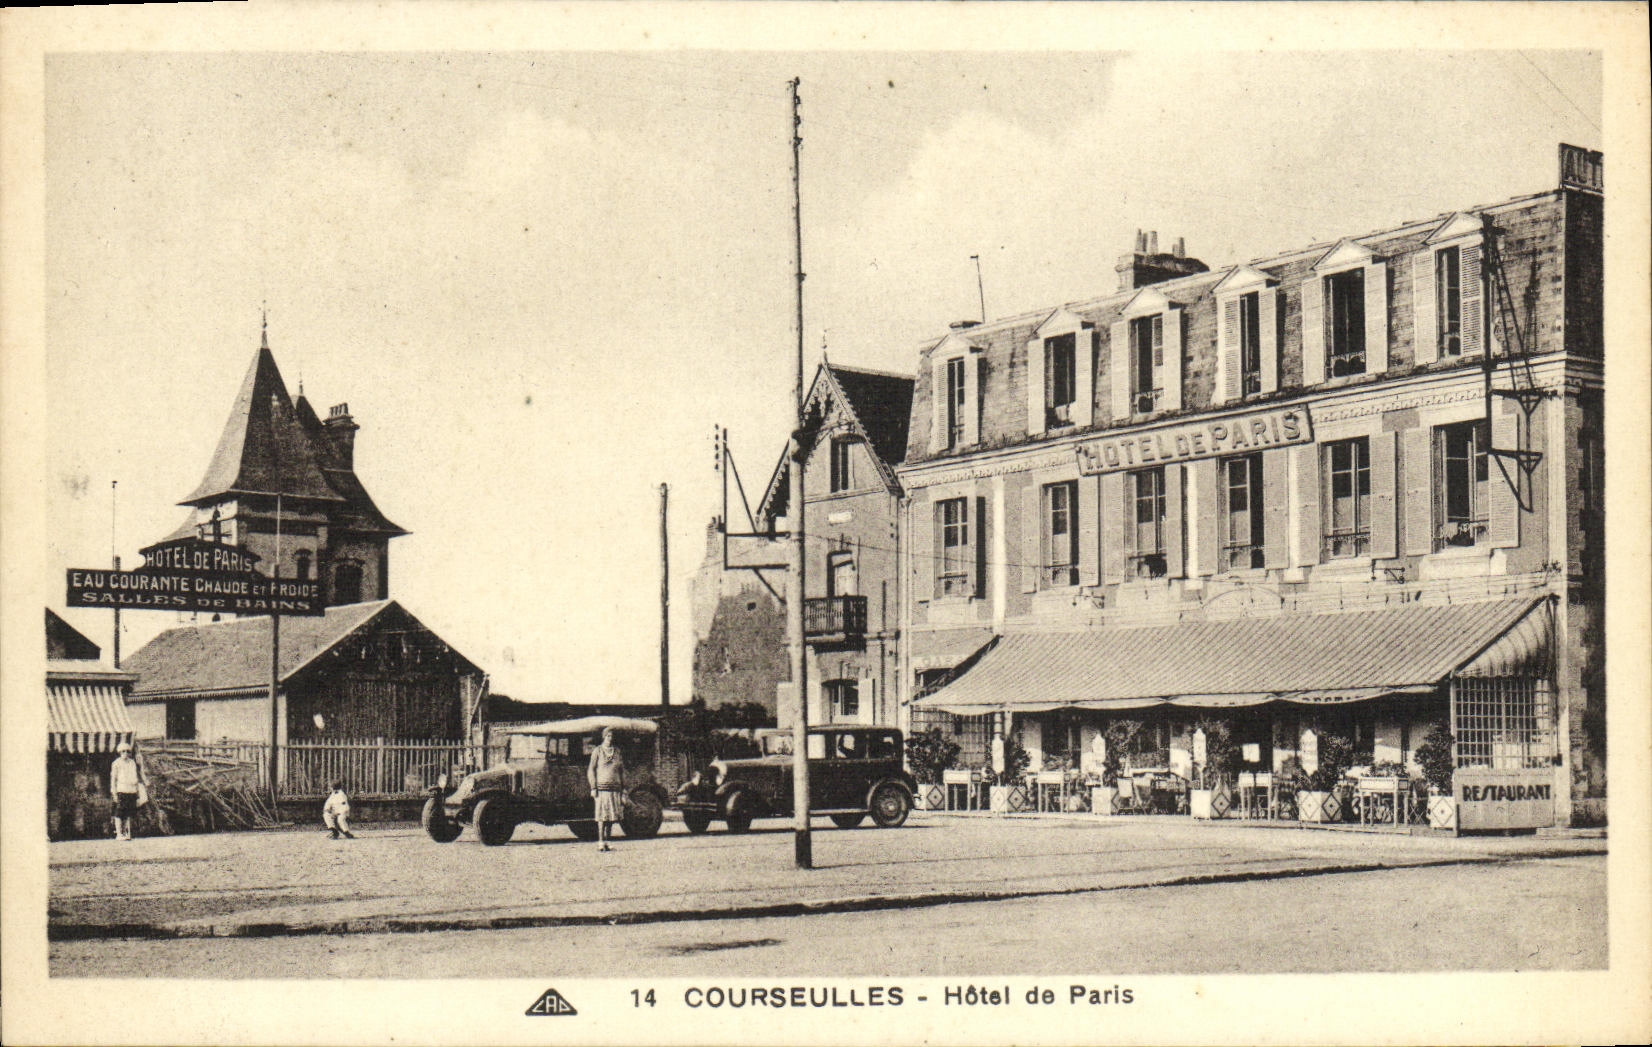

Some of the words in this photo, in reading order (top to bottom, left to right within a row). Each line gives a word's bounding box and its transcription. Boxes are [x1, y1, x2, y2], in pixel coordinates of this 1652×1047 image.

[1082, 434, 1173, 471] HOTEL
[1175, 431, 1206, 457] DE
[1207, 411, 1302, 452] PARIS
[146, 546, 190, 569] HOTEL
[193, 551, 209, 570] DE
[214, 550, 252, 573] PARIS
[72, 572, 104, 588] EAU
[110, 574, 190, 592] COURANTE
[195, 578, 248, 594] CHAUDE
[271, 583, 319, 597] FROIDE
[81, 592, 187, 605] SALLES
[197, 598, 226, 608] DE
[235, 599, 311, 611] BAINS
[1462, 784, 1551, 801] RESTAURANT
